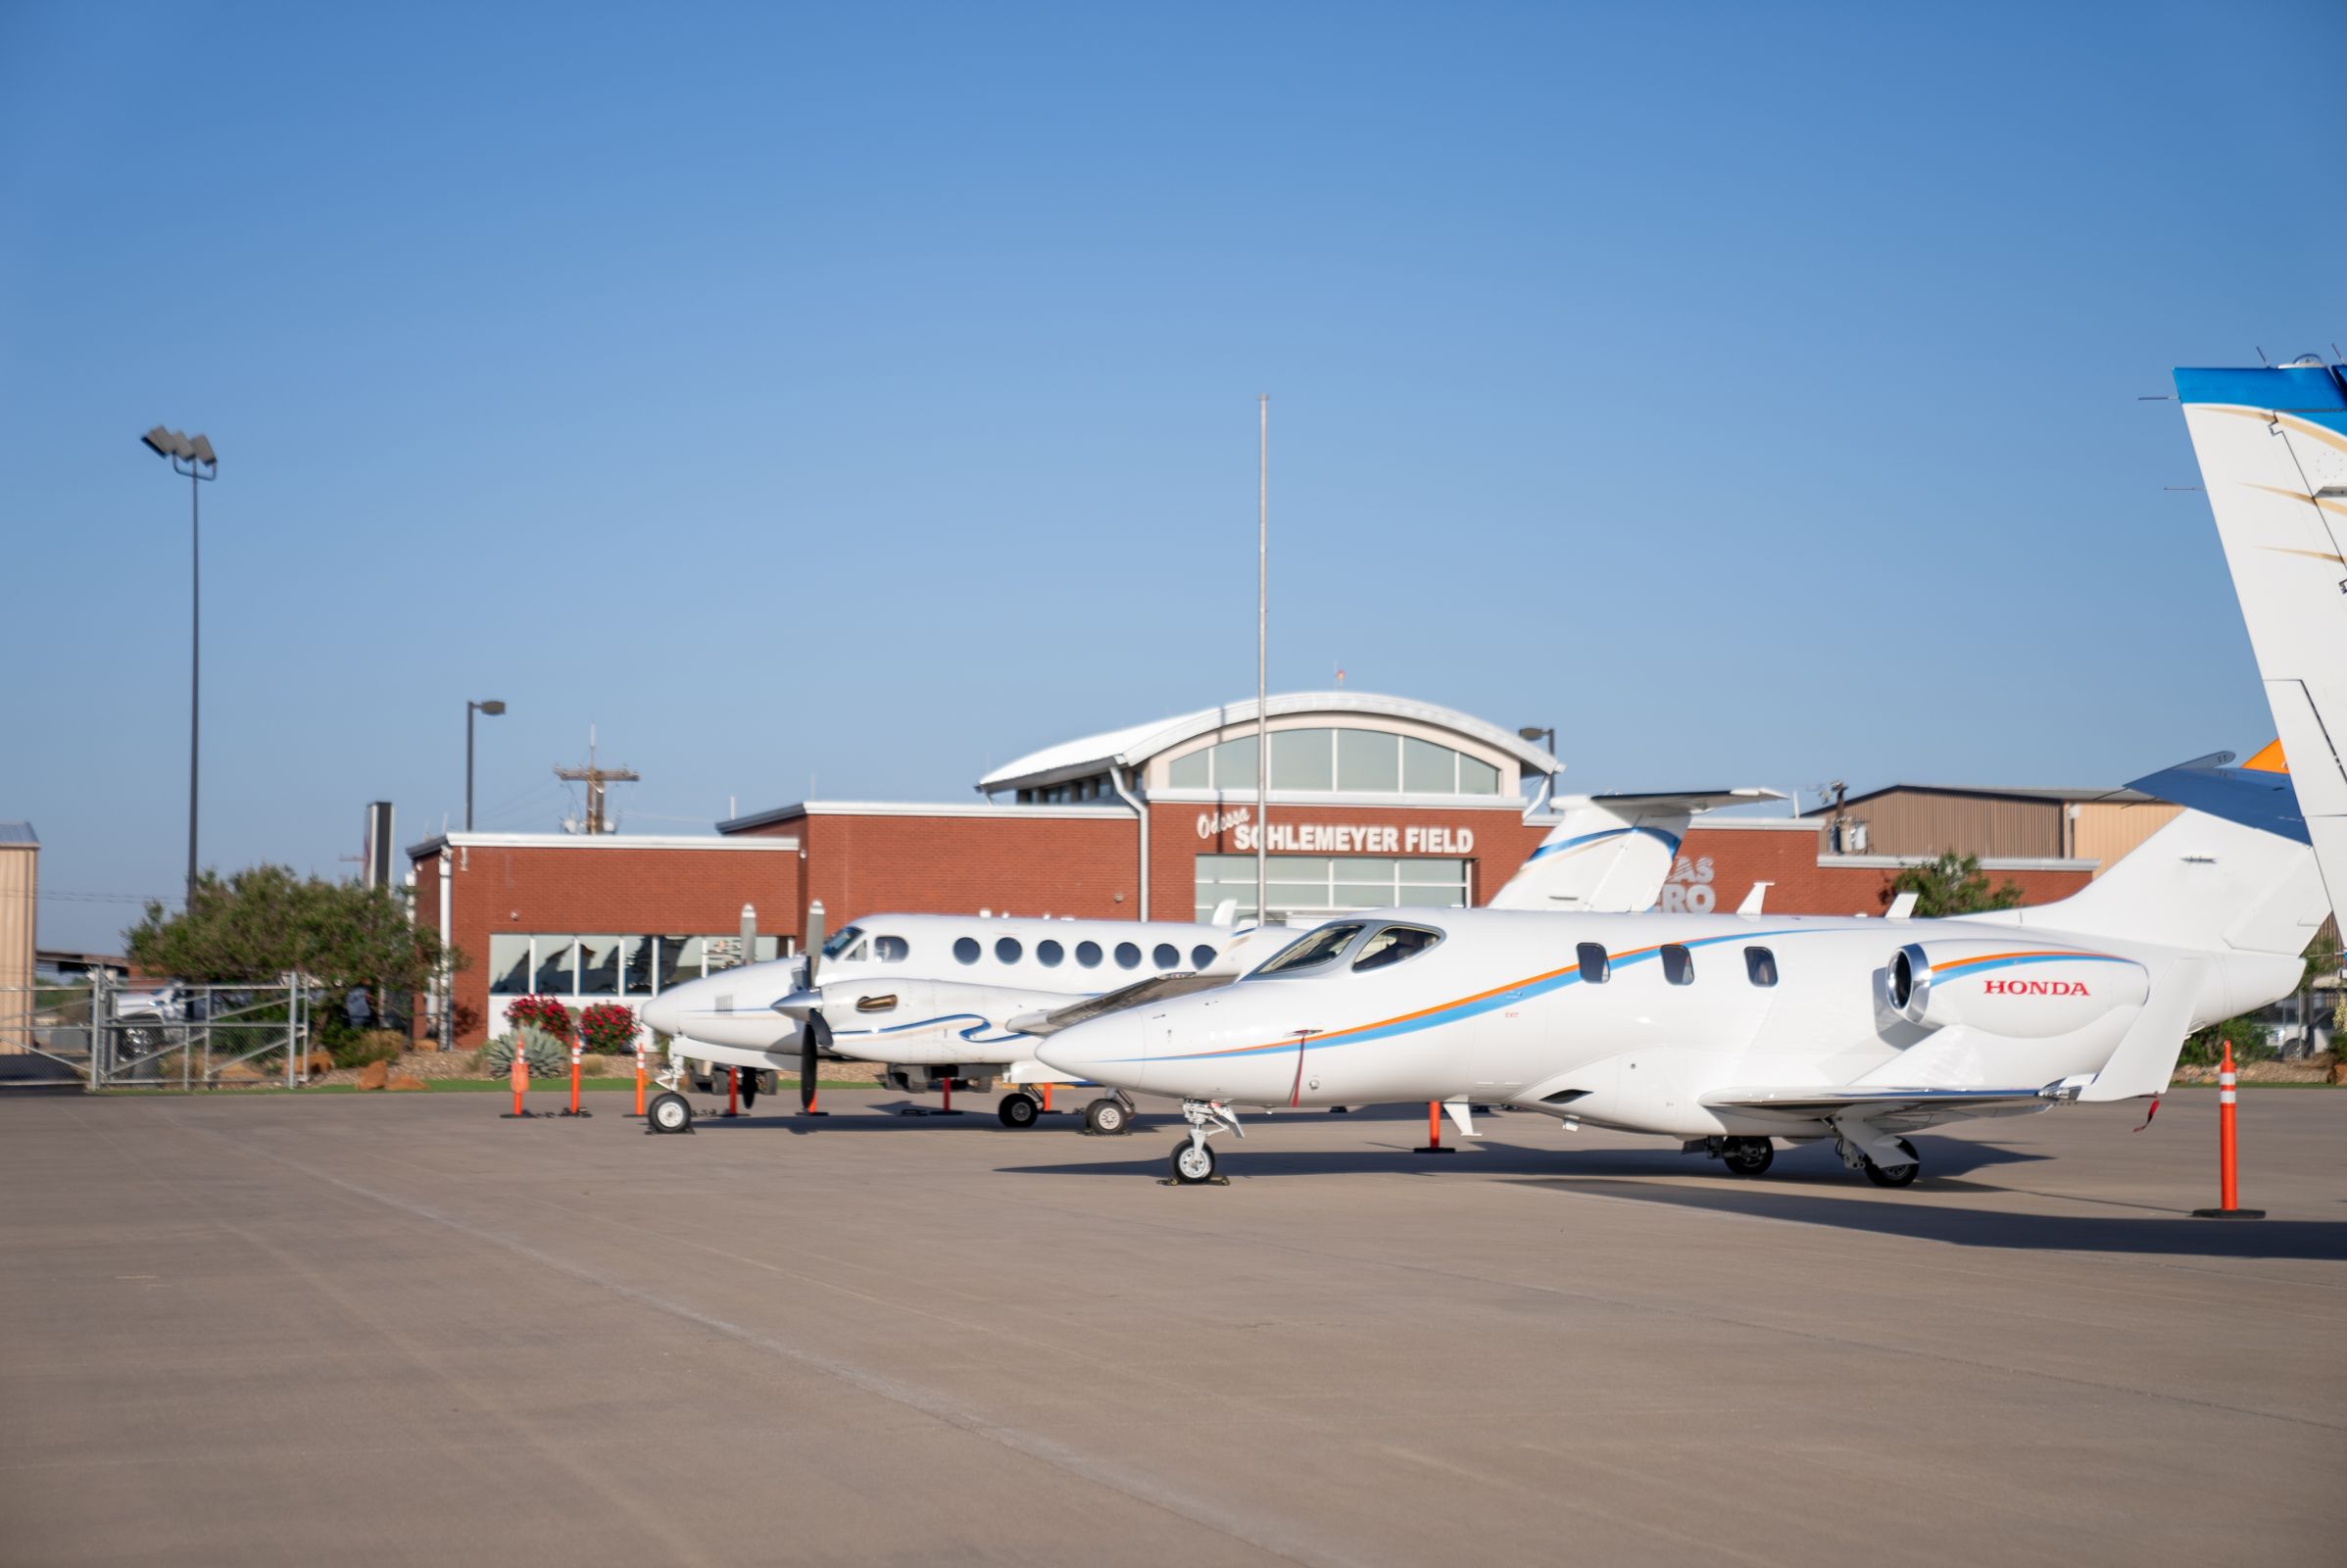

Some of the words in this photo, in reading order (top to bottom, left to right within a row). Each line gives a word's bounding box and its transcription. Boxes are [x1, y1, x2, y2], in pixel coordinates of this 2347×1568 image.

[1197, 808, 1250, 840] Odessa
[1234, 824, 1398, 852] SCHLEMEYER
[1405, 827, 1474, 854] FIELD
[1983, 980, 2090, 996] HONDA
